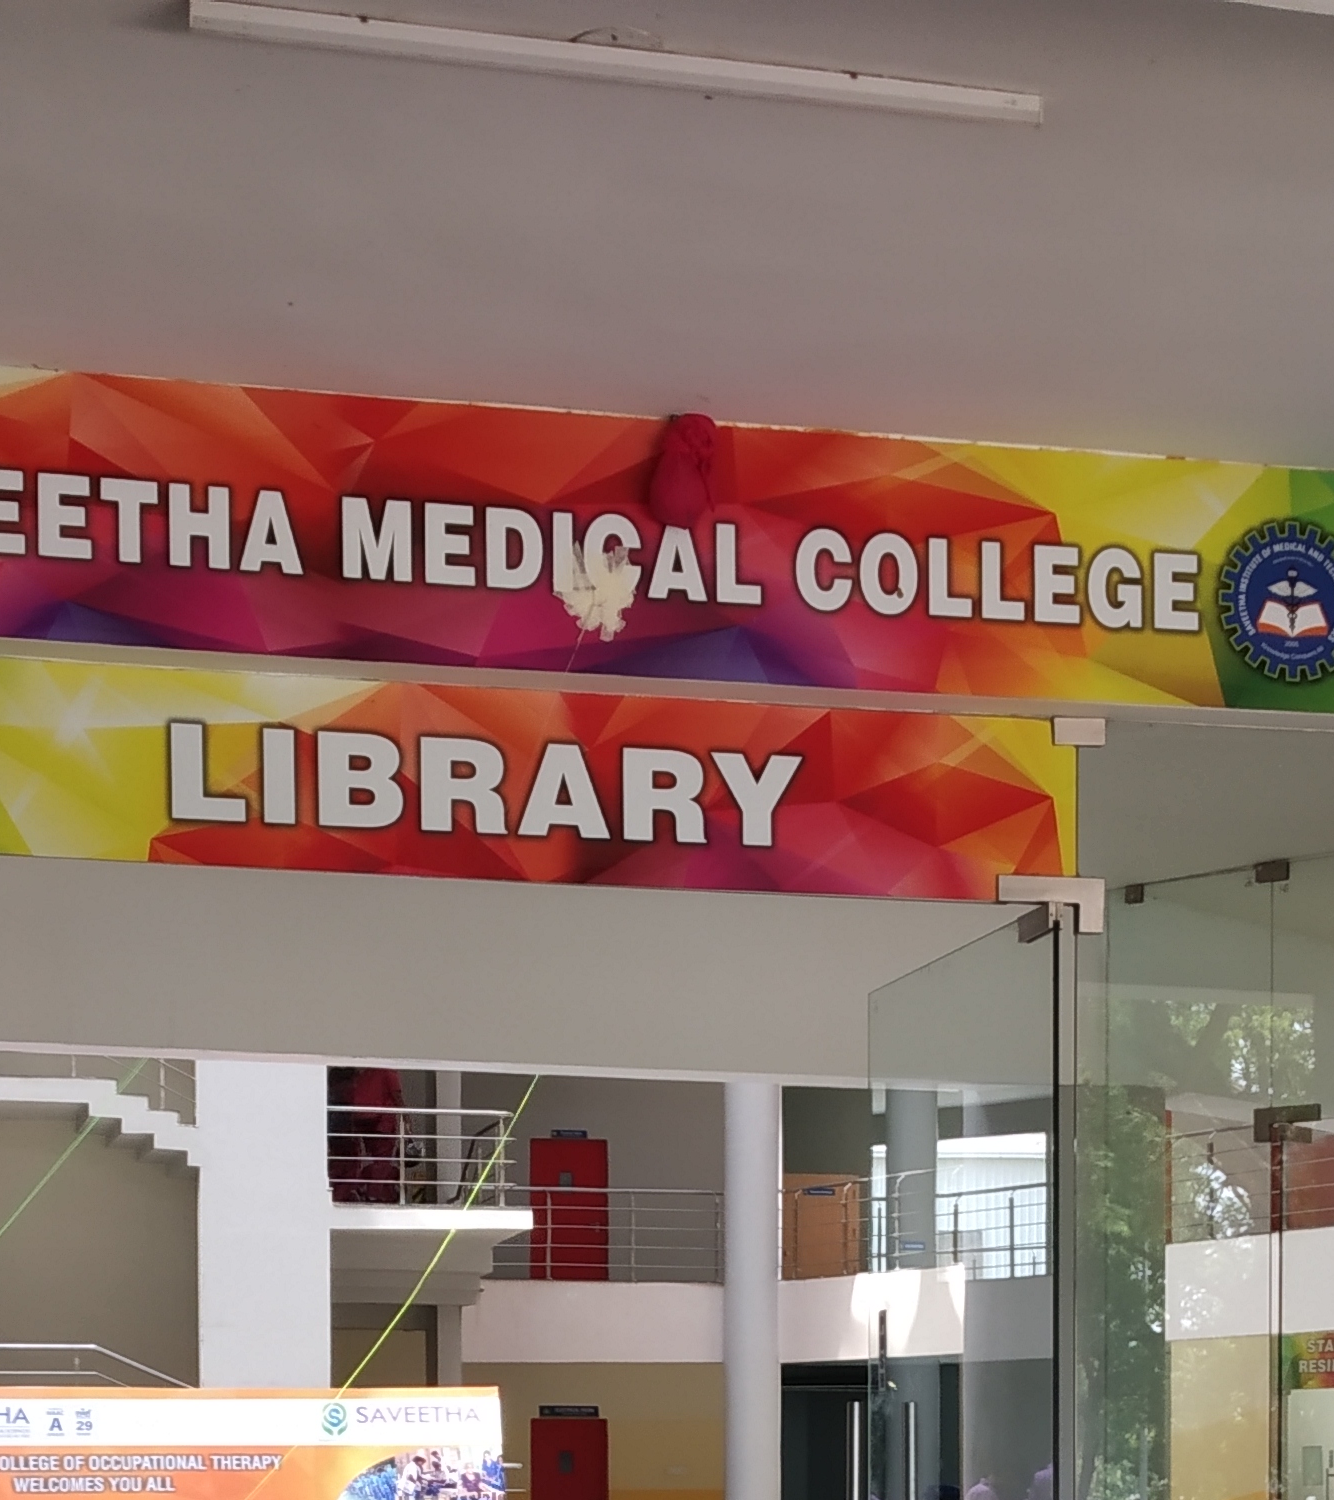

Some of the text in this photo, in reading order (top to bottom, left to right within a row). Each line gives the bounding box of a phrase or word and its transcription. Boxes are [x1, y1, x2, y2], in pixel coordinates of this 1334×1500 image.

[1273, 542, 1306, 553] MEDICAL
[1308, 547, 1325, 562] AND
[341, 496, 763, 605] MEDICAL
[795, 528, 1200, 632] COLLEGE
[169, 722, 803, 847] LIBRARY
[356, 1406, 480, 1423] SAVEETHA
[76, 1420, 93, 1431] 29
[63, 1455, 85, 1470] OF
[89, 1455, 207, 1471] OCCUPATIONAL
[210, 1455, 282, 1470] THERAPY
[14, 1477, 175, 1492] WELCOMES YOU ALL
